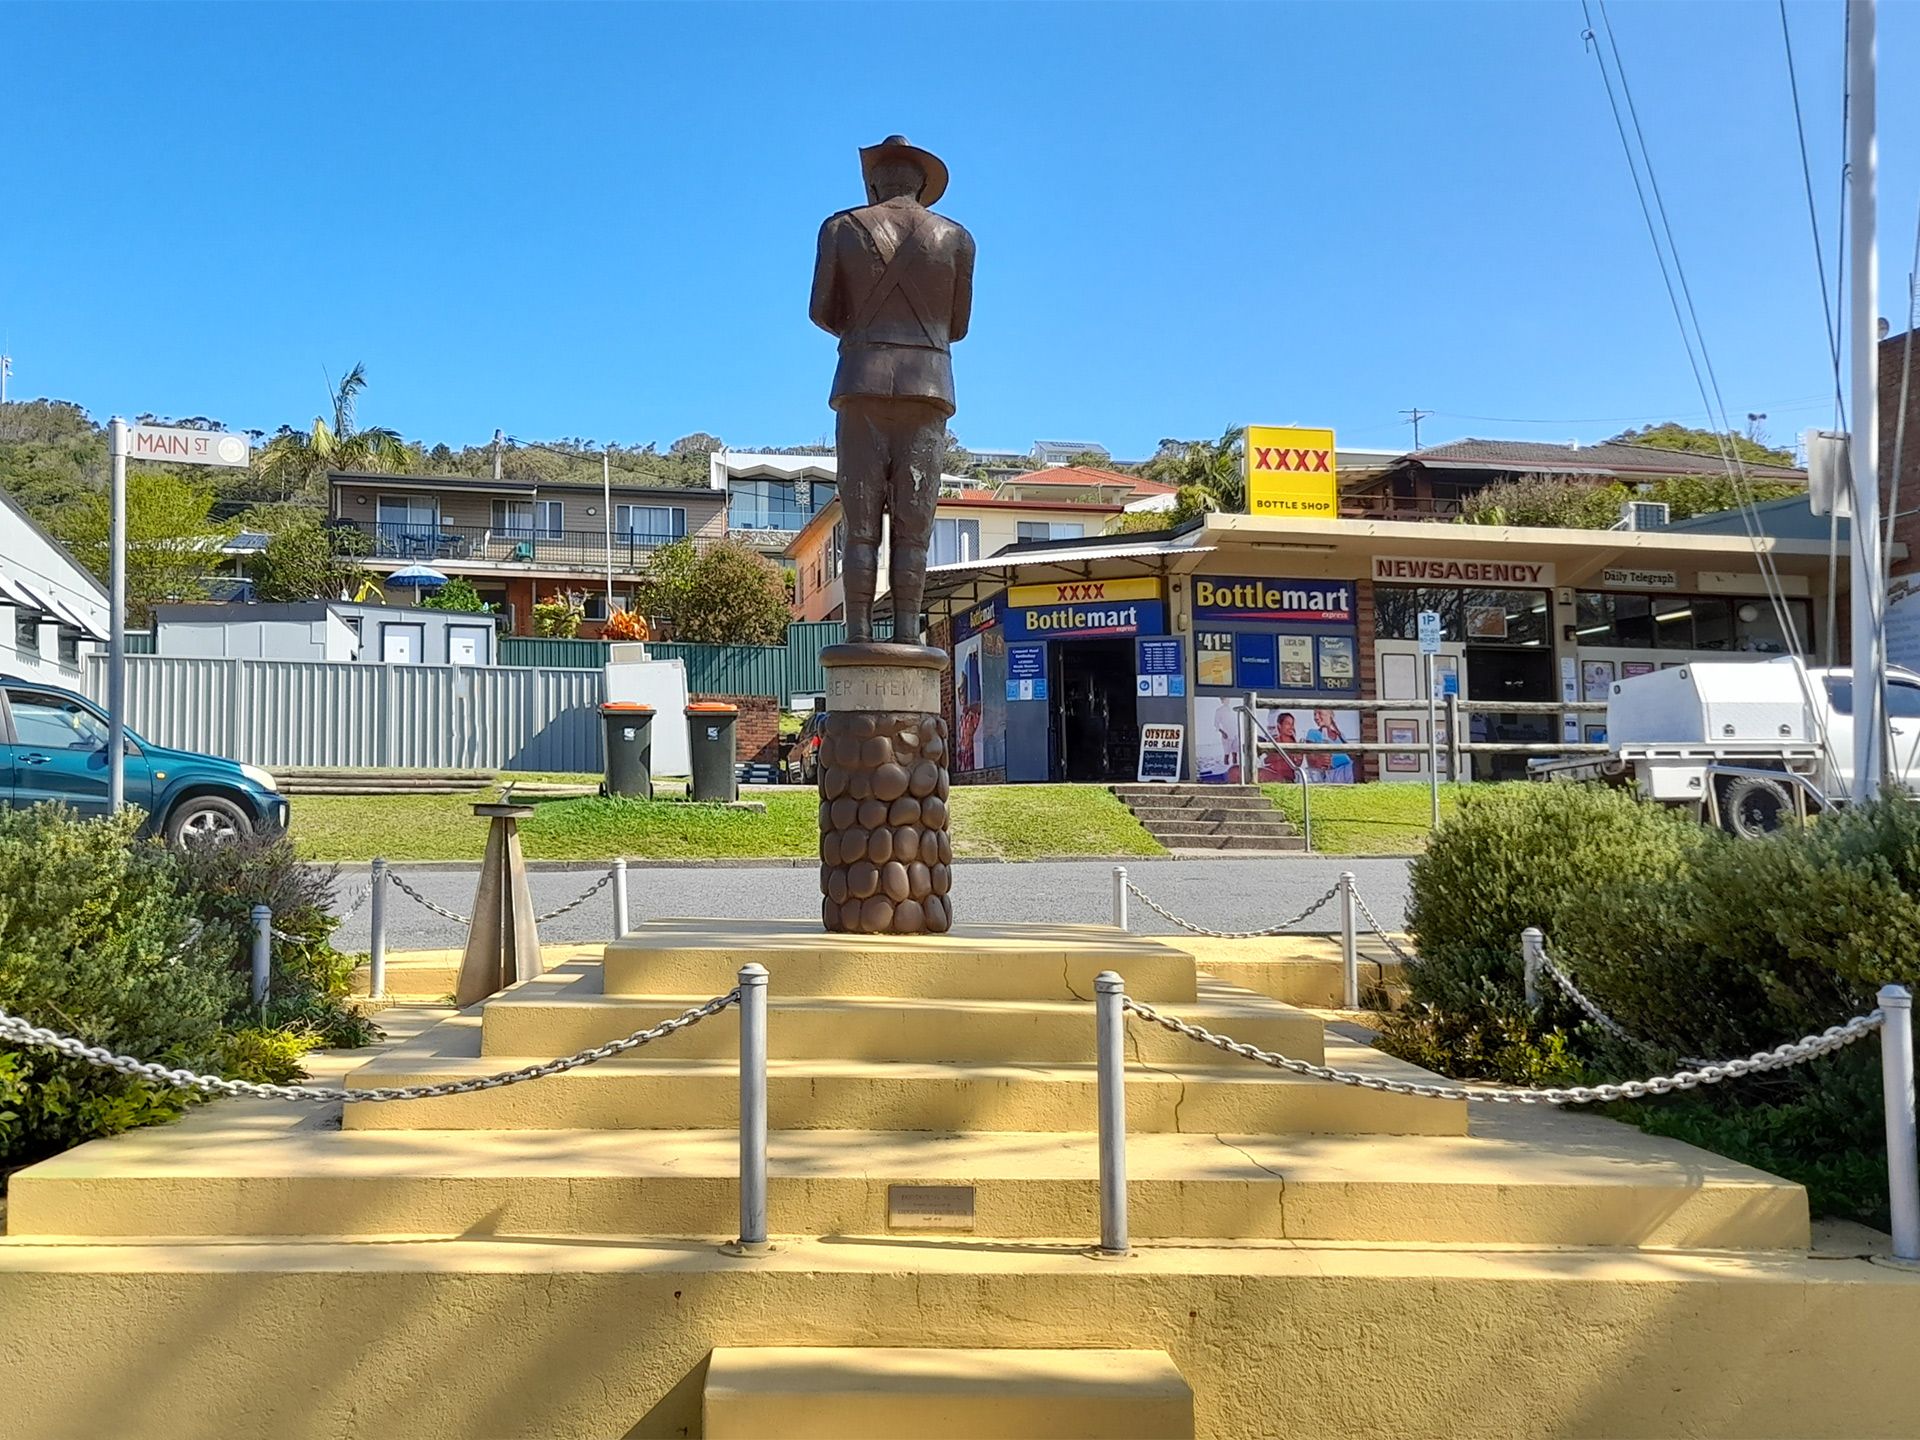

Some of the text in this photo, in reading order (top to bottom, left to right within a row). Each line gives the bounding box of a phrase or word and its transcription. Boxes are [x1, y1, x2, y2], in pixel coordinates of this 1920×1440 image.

[137, 432, 210, 456] MAIN ST
[1254, 447, 1330, 473] XXXX
[1256, 500, 1330, 510] BOTTLE SHOP
[1376, 559, 1544, 583] NEWSAGENCY
[1604, 571, 1675, 585] Daily Telegraph
[1057, 583, 1105, 601] XXXX
[1196, 581, 1350, 611] Bottlemart
[970, 601, 996, 629] Bottlemart
[1026, 606, 1138, 631] Bottlemart
[1321, 612, 1349, 620] express
[1422, 615, 1436, 625] 1P
[1115, 625, 1137, 633] express
[862, 680, 915, 697] THEM
[1145, 729, 1181, 740] OYSTERS
[1144, 740, 1180, 749] FOR SALE
